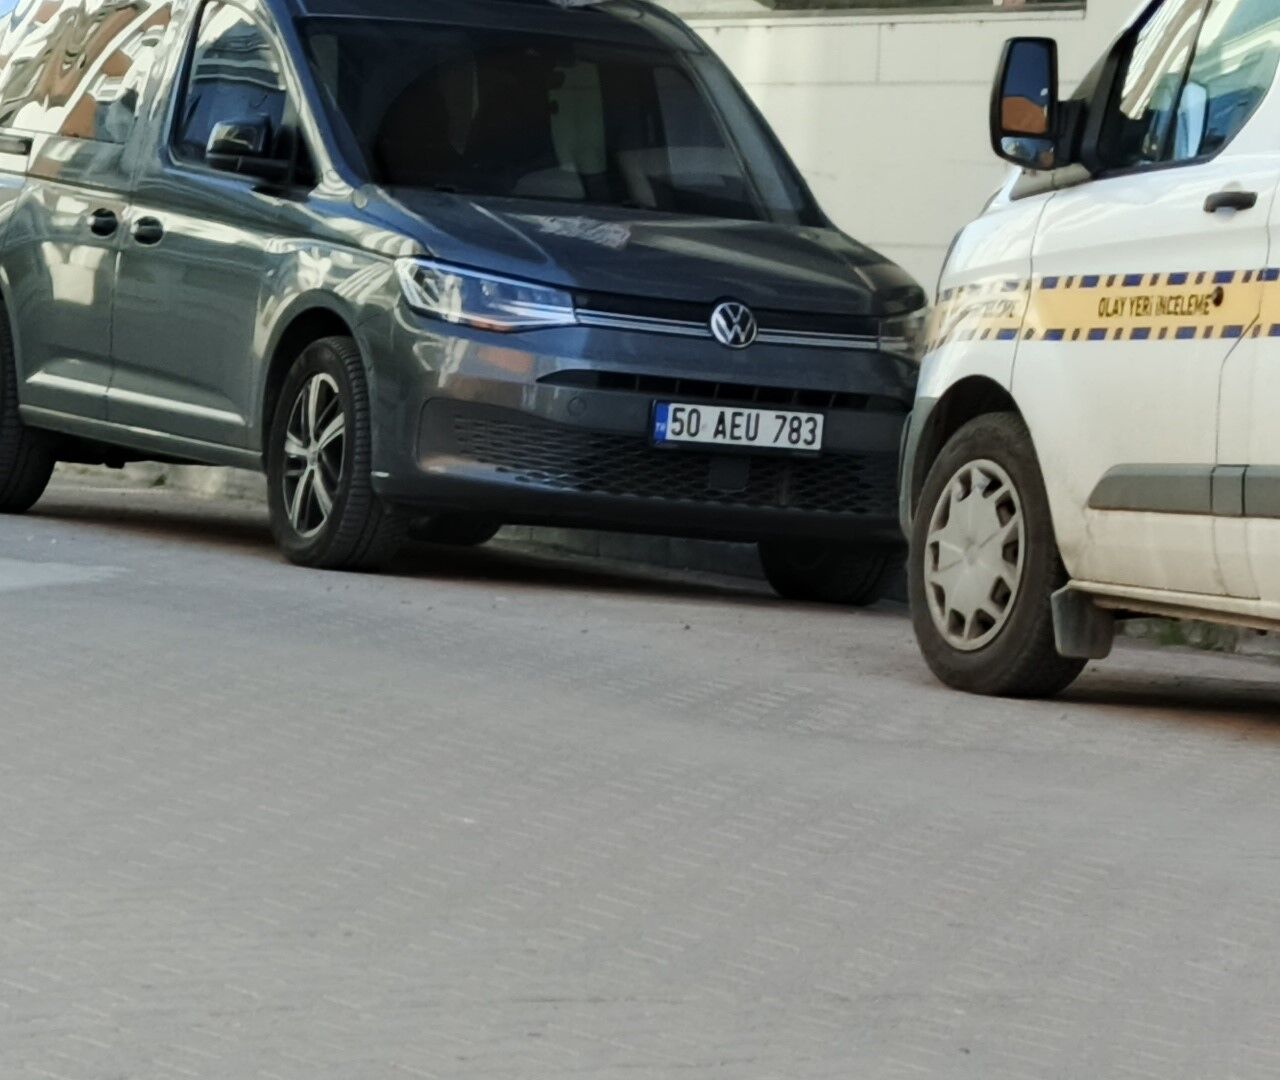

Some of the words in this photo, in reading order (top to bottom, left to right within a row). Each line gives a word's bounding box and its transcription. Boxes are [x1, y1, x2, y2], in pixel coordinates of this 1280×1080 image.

[1098, 297, 1127, 317] OLAY
[671, 407, 701, 437] 50
[713, 411, 760, 441] AEU
[773, 415, 818, 446] 783
